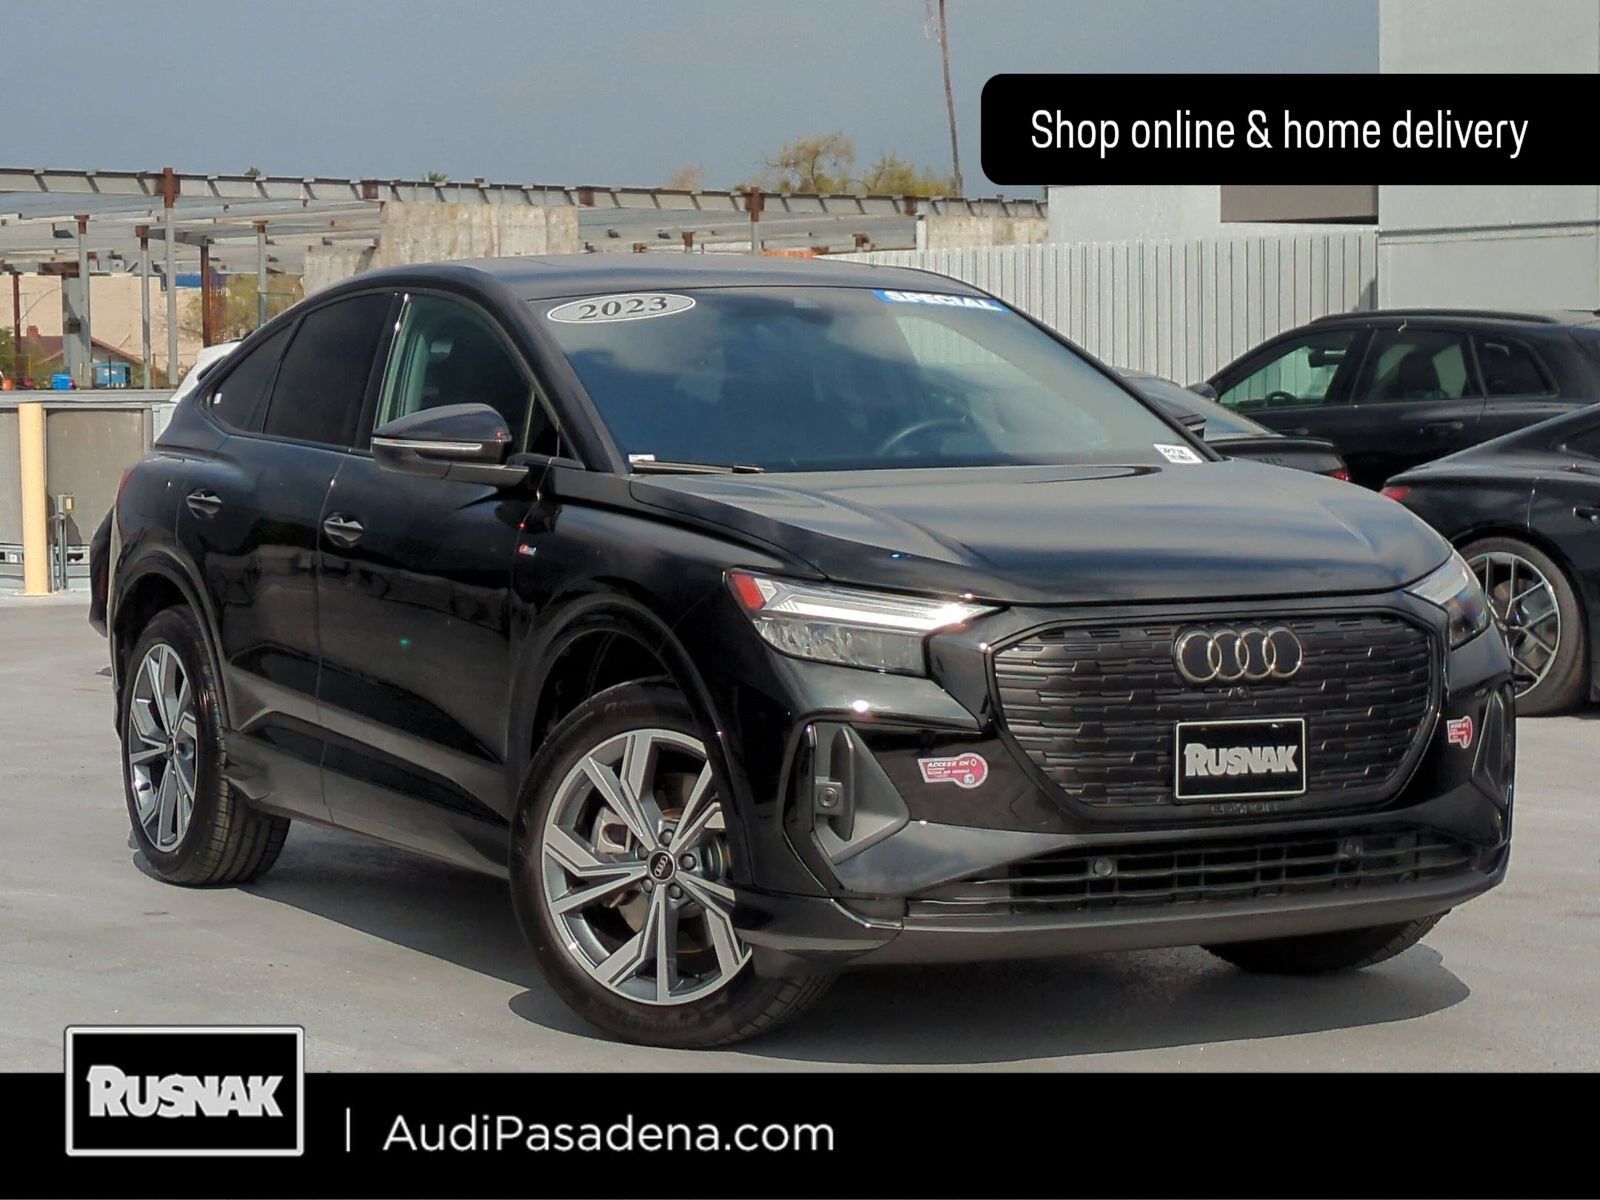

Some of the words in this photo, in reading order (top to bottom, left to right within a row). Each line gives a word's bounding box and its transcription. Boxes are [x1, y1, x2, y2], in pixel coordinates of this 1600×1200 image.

[578, 296, 668, 320] 2023
[883, 290, 1003, 311] SPECIAL
[1184, 743, 1298, 777] RUSNAK
